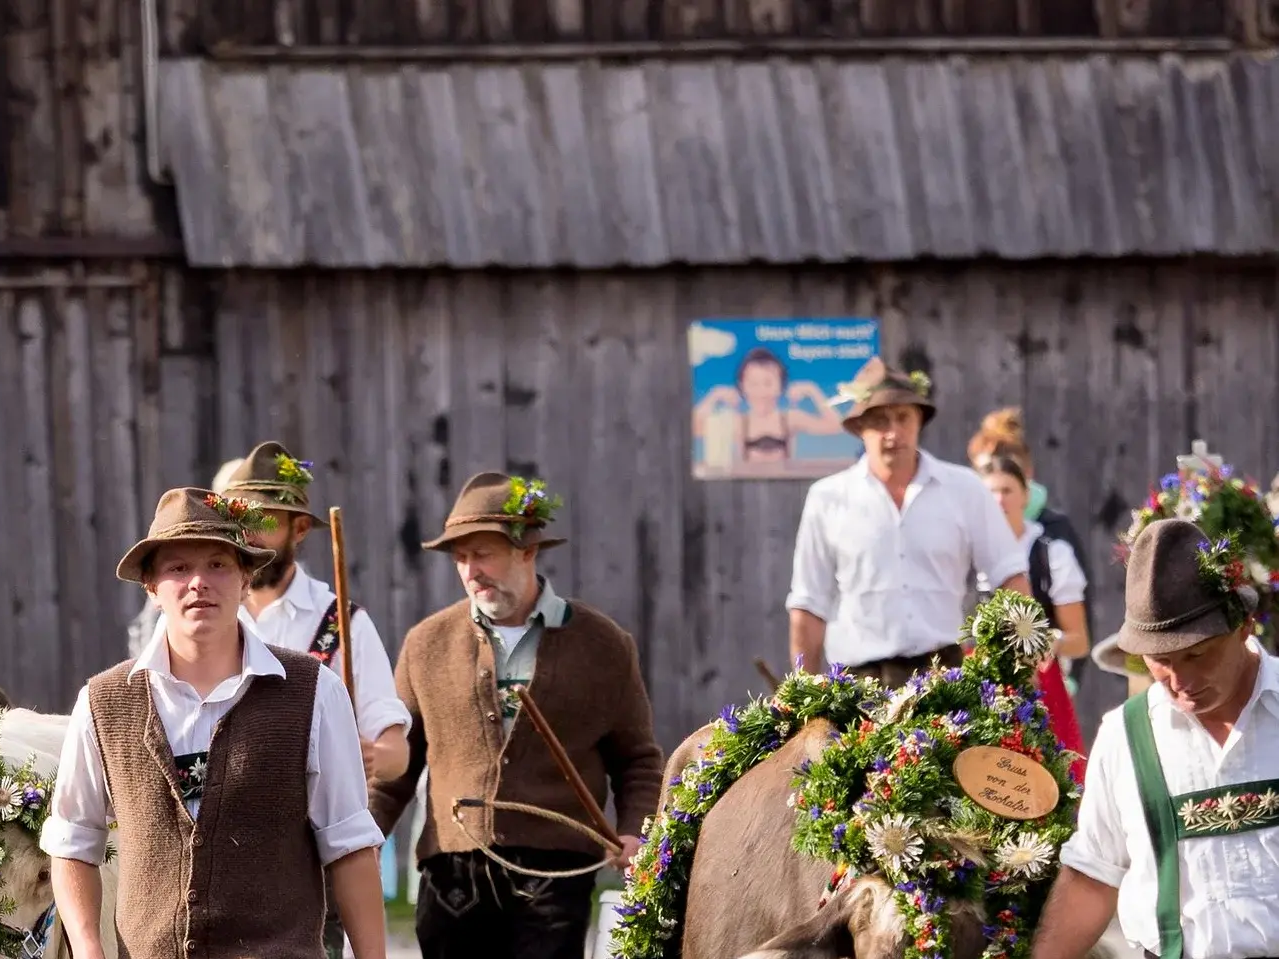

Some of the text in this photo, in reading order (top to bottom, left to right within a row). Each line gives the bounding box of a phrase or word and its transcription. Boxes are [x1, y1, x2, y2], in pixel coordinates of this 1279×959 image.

[996, 756, 1028, 777] Gruss
[986, 775, 1031, 795] von der
[978, 787, 1030, 813] Hochalpe
